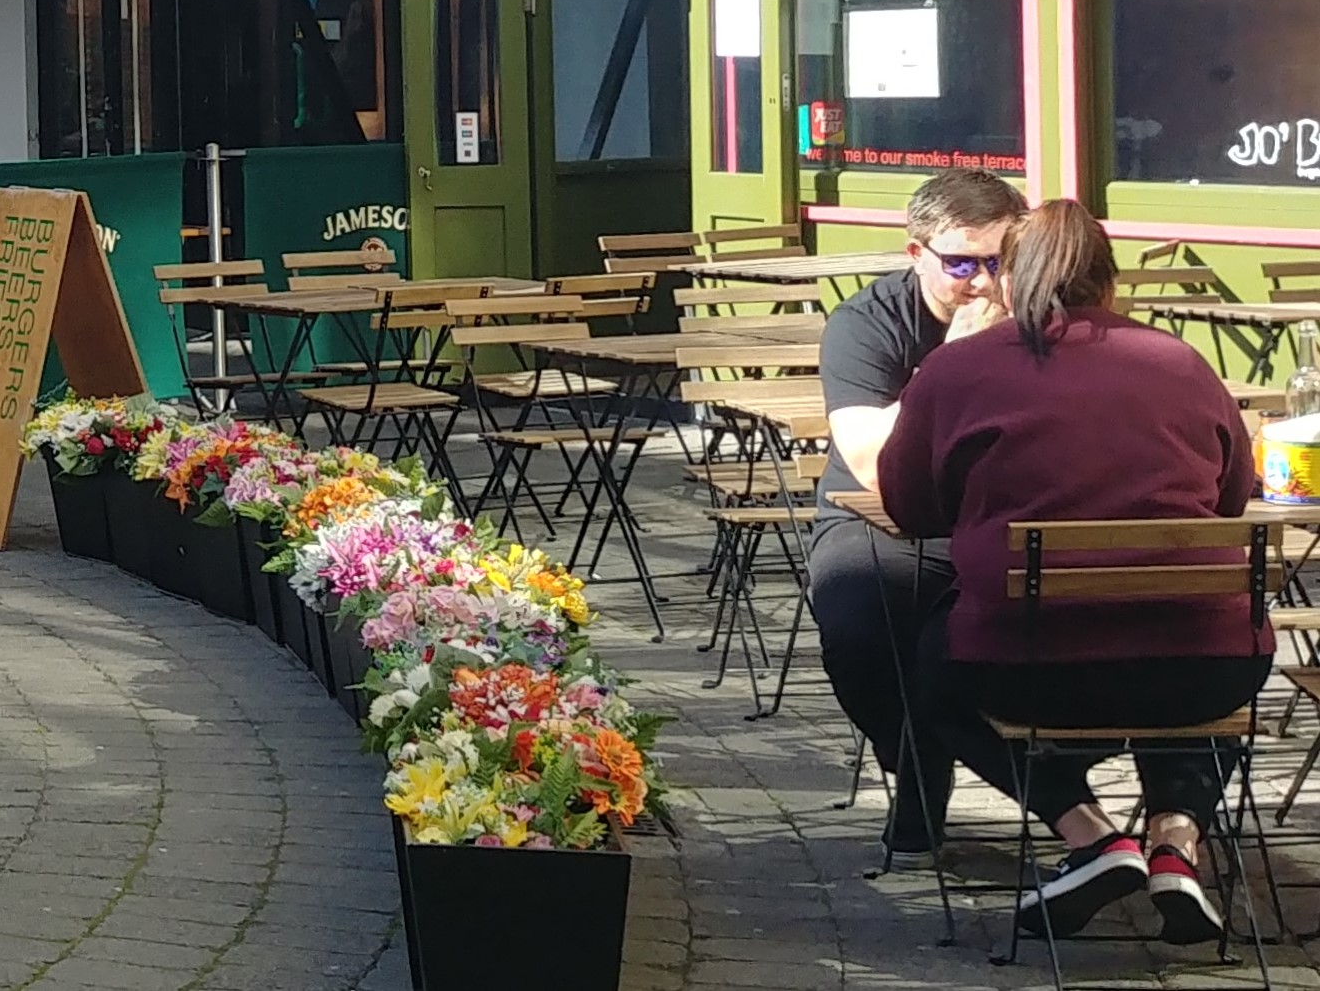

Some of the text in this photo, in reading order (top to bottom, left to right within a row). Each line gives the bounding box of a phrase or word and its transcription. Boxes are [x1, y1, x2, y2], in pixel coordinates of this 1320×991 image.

[814, 108, 843, 123] JUST
[820, 120, 843, 133] EAT
[806, 147, 861, 163] weme
[864, 149, 878, 164] to
[880, 151, 902, 166] our
[905, 150, 950, 167] smoke
[952, 150, 979, 169] free
[323, 205, 410, 241] JAMESO
[0, 218, 55, 421] BURGERS
